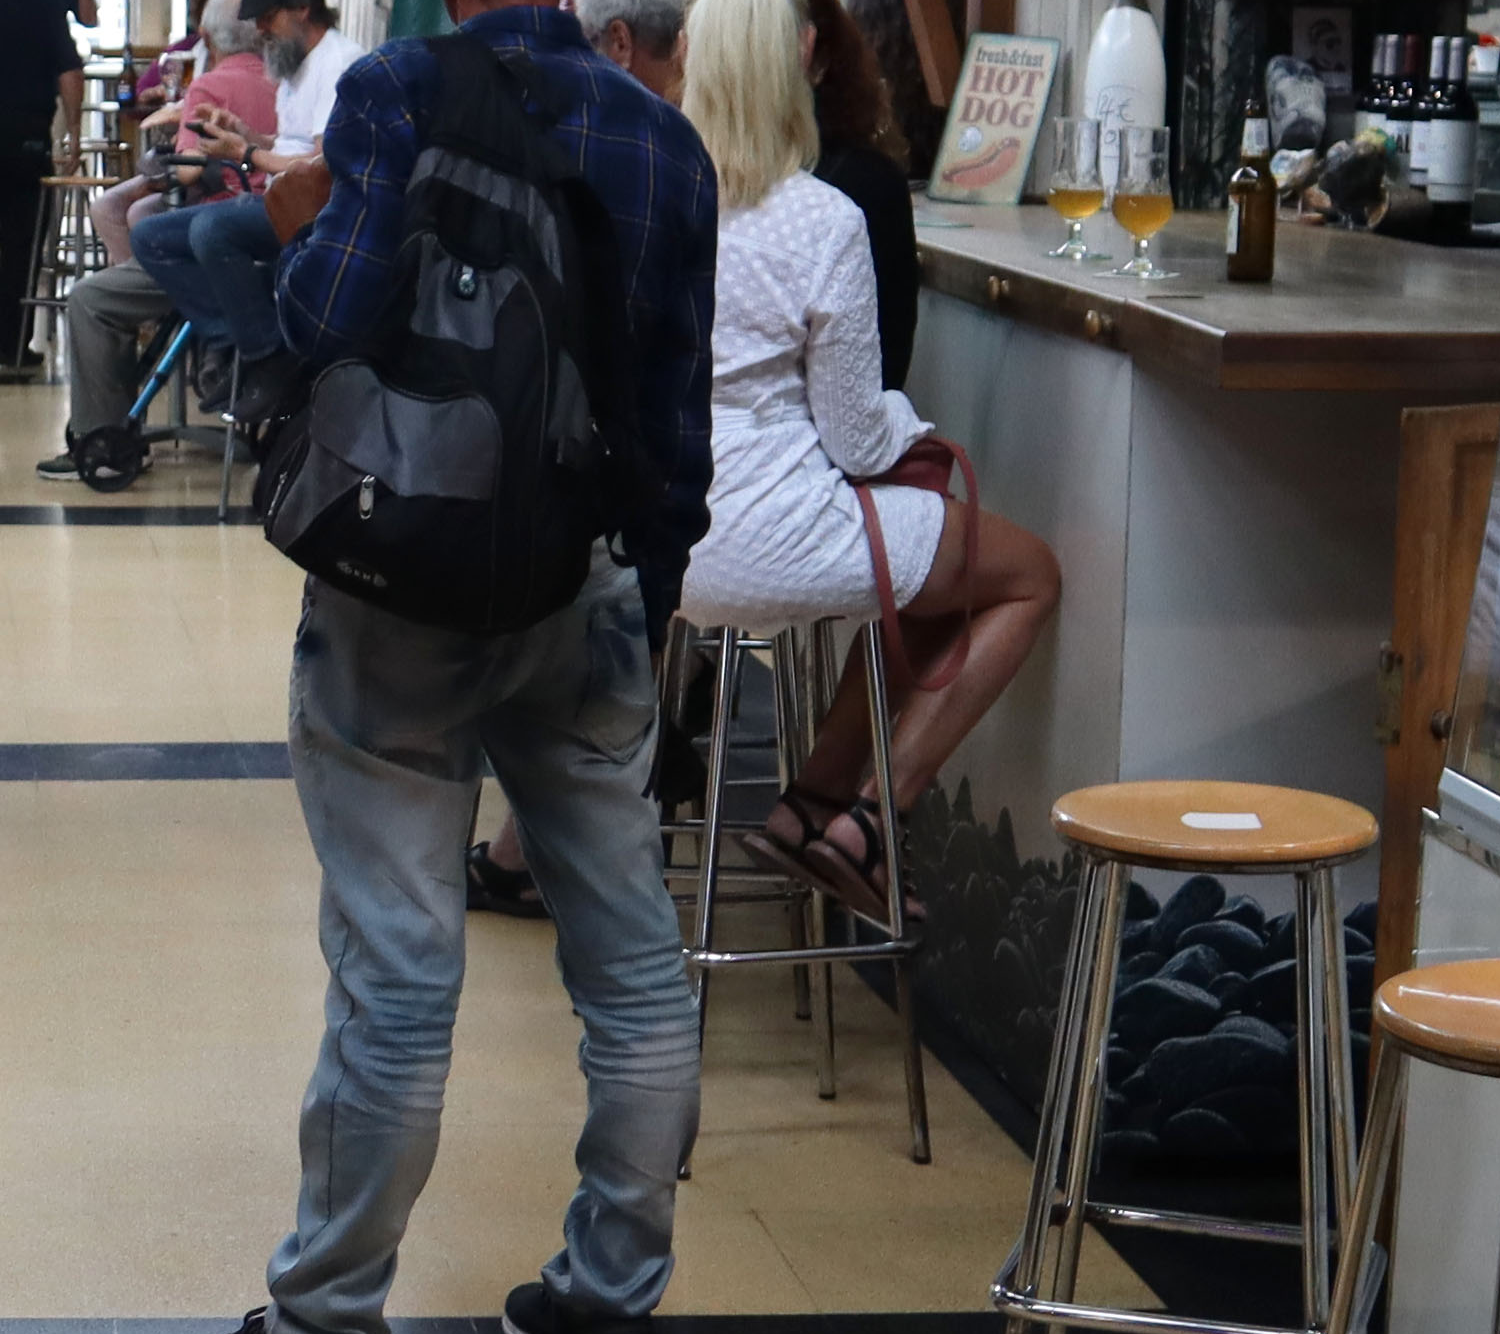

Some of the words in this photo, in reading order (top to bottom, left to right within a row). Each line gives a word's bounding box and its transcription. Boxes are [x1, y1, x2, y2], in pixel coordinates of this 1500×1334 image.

[976, 45, 1045, 68] fresh&fast
[968, 65, 1044, 98] HOT
[958, 96, 1036, 129] DOG
